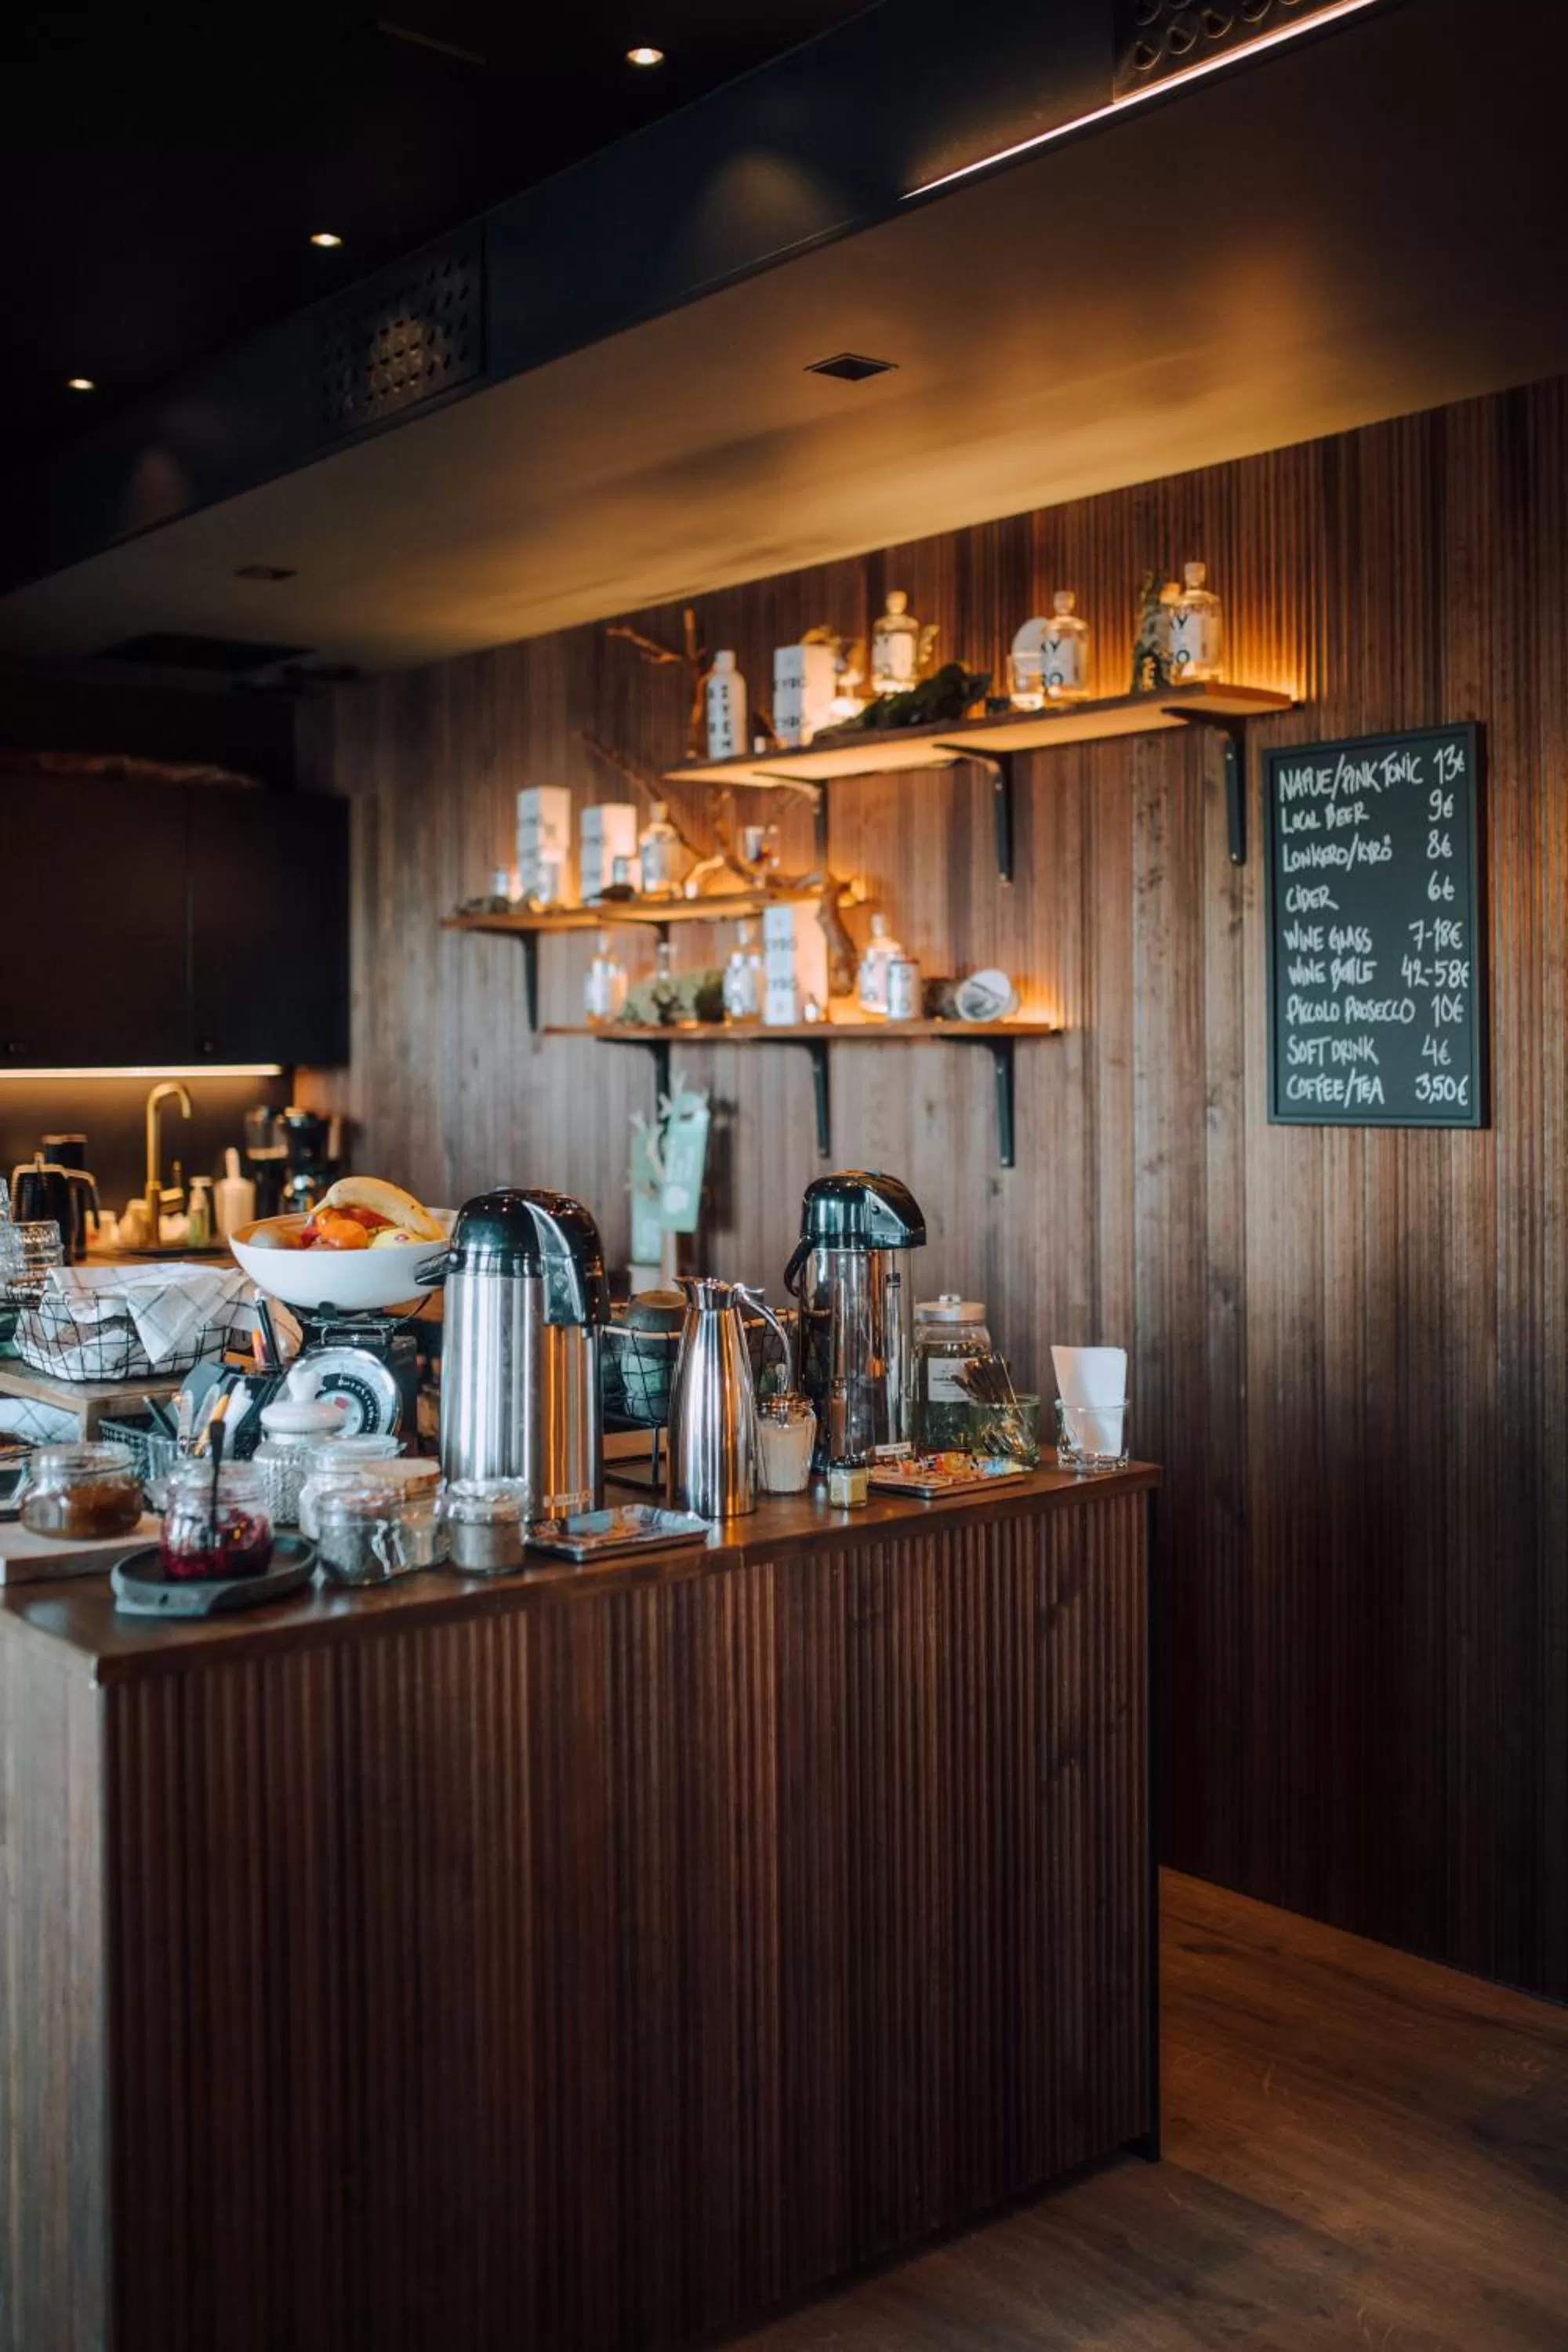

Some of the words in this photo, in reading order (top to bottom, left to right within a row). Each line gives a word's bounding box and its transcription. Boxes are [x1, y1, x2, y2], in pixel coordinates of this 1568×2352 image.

[1380, 750, 1425, 788] TONIC
[1432, 743, 1465, 785] 13€
[1280, 807, 1322, 835] LOCAL
[1325, 800, 1370, 830] BEER
[1428, 788, 1454, 822] 9€
[1426, 829, 1454, 859] 8€
[1285, 884, 1340, 913] CIDER
[1427, 869, 1456, 902] 6€
[1283, 920, 1324, 952] WINE
[1328, 924, 1373, 954] GLASS
[1408, 916, 1464, 952] 7-18€
[1287, 956, 1327, 987] WINE
[1401, 953, 1470, 989] 42-58€
[1285, 993, 1341, 1026] PICCOLO
[1344, 996, 1416, 1024] PROSECCO
[1430, 993, 1465, 1029] 10€
[1287, 1034, 1332, 1065] SOFT
[1331, 1035, 1380, 1065] DRINK
[1421, 1034, 1452, 1067] 4€
[1286, 1067, 1385, 1109] COFFEE/TEA
[1414, 1072, 1469, 1107] 3,50€
